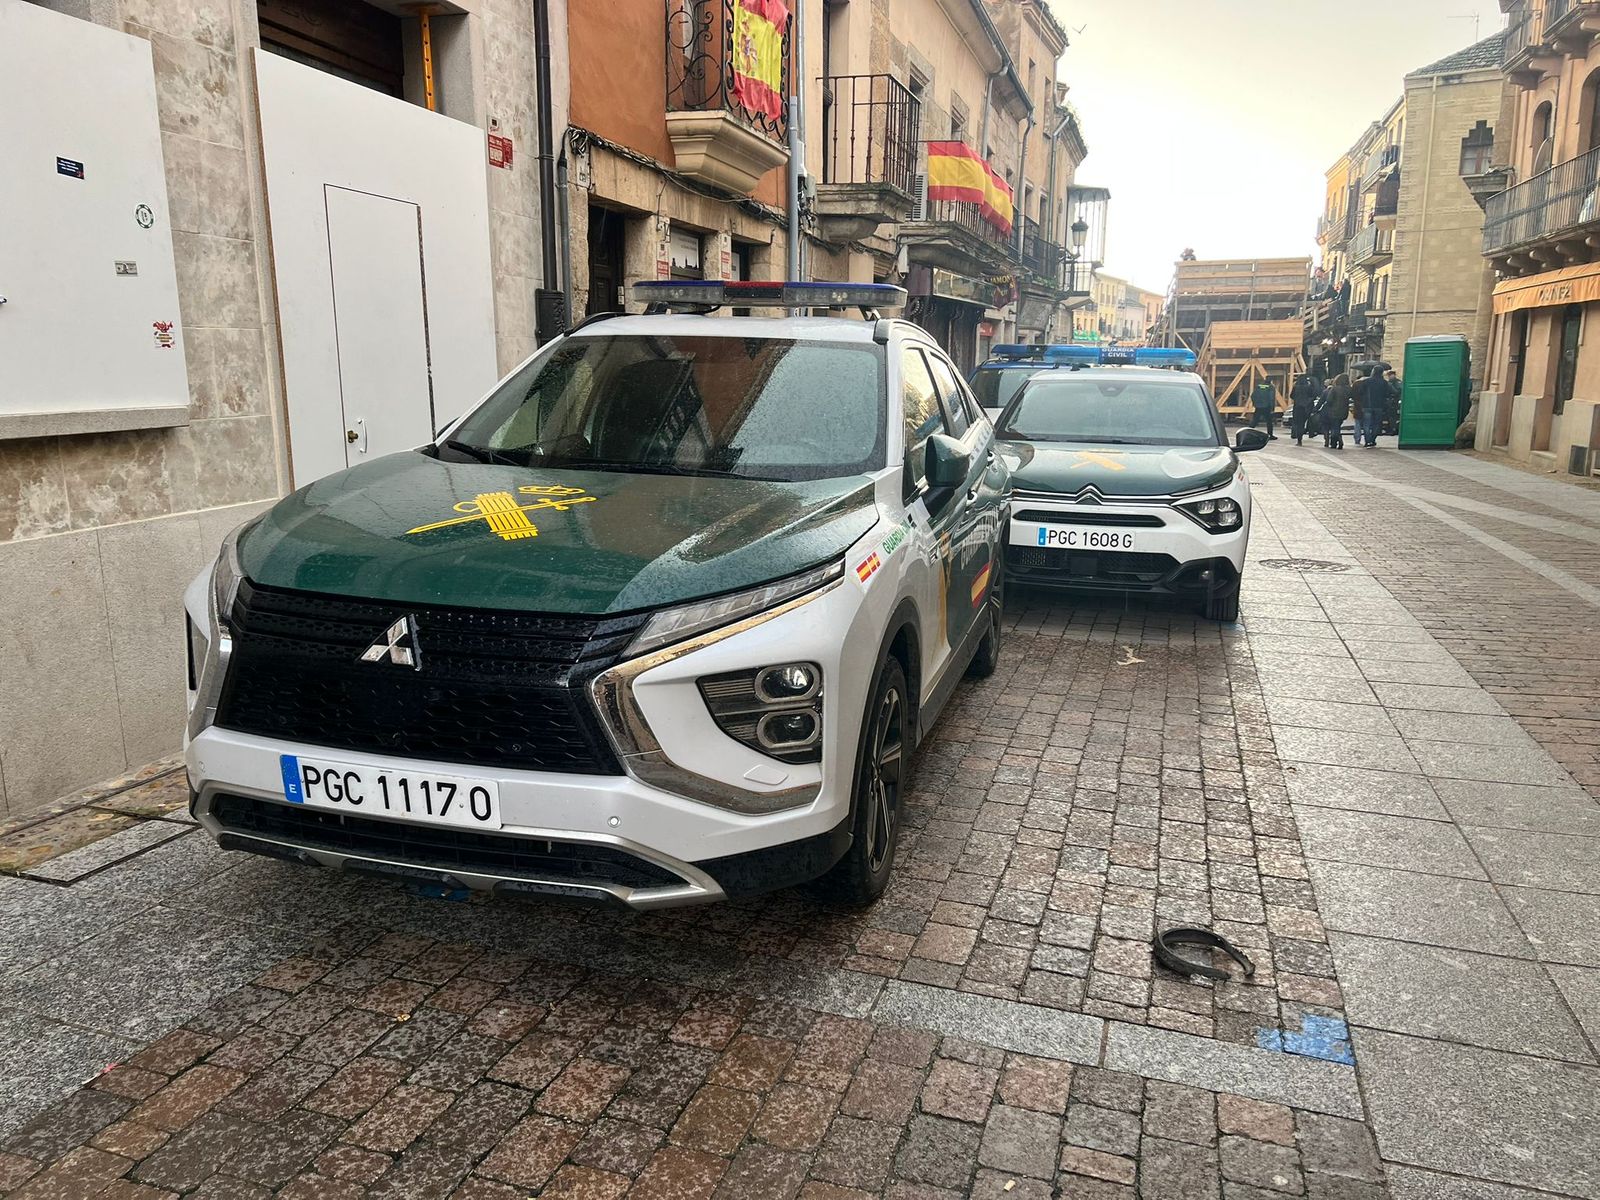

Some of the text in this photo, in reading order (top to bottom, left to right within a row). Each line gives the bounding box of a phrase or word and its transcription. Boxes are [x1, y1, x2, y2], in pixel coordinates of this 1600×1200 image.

[1048, 529, 1133, 549] PGC 1608 G
[289, 784, 297, 793] E
[302, 765, 364, 805] PGC
[377, 775, 458, 817] 1117
